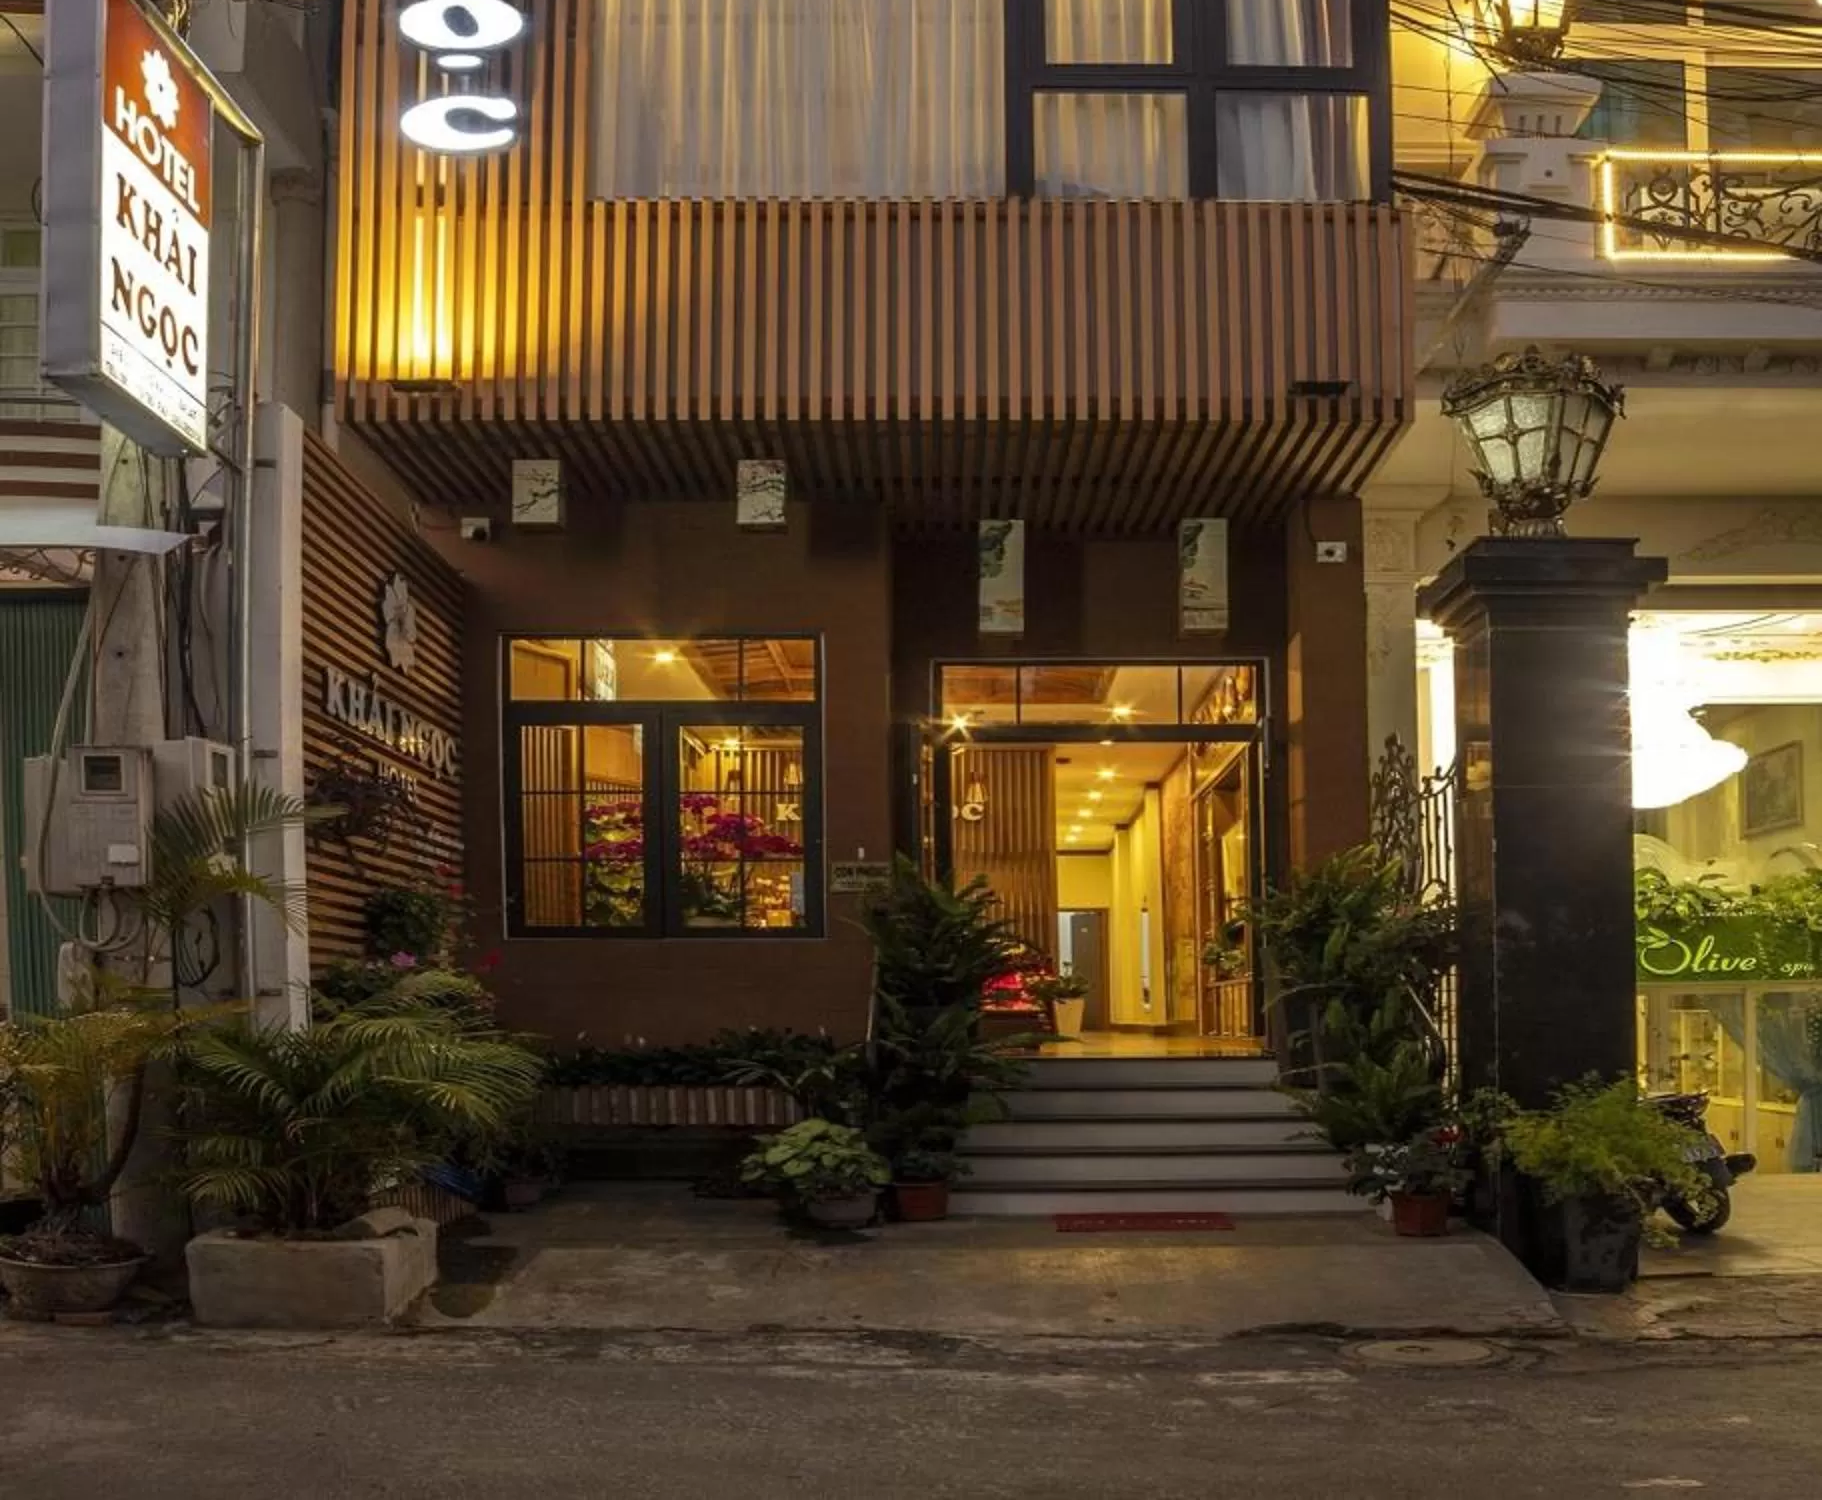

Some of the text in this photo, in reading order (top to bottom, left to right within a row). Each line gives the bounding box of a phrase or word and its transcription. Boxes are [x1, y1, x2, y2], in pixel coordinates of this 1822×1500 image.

[115, 85, 199, 213] HOTEL
[111, 256, 198, 376] NGỌC
[1639, 928, 1757, 975] Olive
